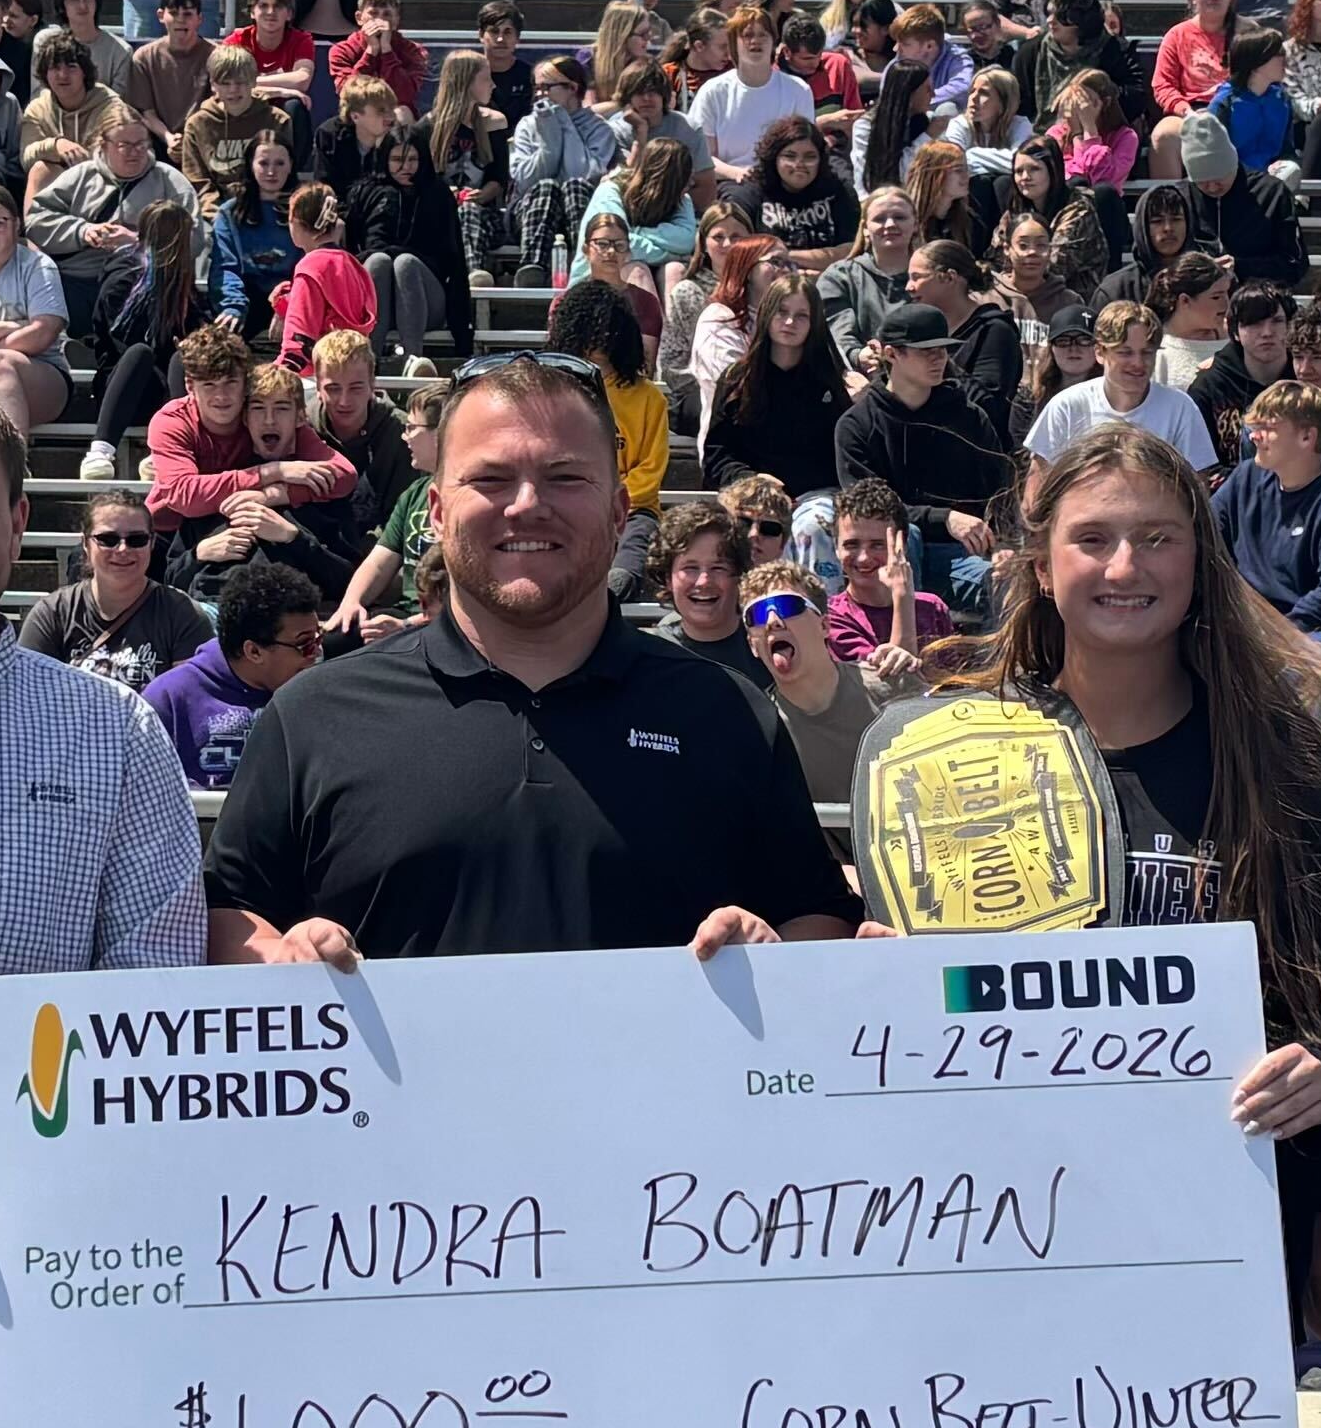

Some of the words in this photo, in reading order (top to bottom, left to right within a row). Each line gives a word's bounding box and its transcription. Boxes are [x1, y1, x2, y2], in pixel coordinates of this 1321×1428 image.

[947, 754, 1002, 814] BELT
[1014, 788, 1041, 856] AWAD
[934, 838, 966, 893] WYFFELS
[971, 843, 1026, 914] CORN
[943, 955, 1196, 1014] BOUND
[88, 1003, 349, 1059] WYFFELS
[850, 1023, 1213, 1087] 4-29-2026
[92, 1066, 351, 1125] HYBRIDS
[746, 1069, 815, 1097] Date
[25, 1245, 80, 1276] Pay
[88, 1246, 123, 1270] to
[130, 1239, 184, 1270] the
[215, 1194, 567, 1303] KENDRA
[642, 1166, 1066, 1273] BOATMAN
[50, 1276, 149, 1310] Order
[152, 1273, 186, 1305] of
